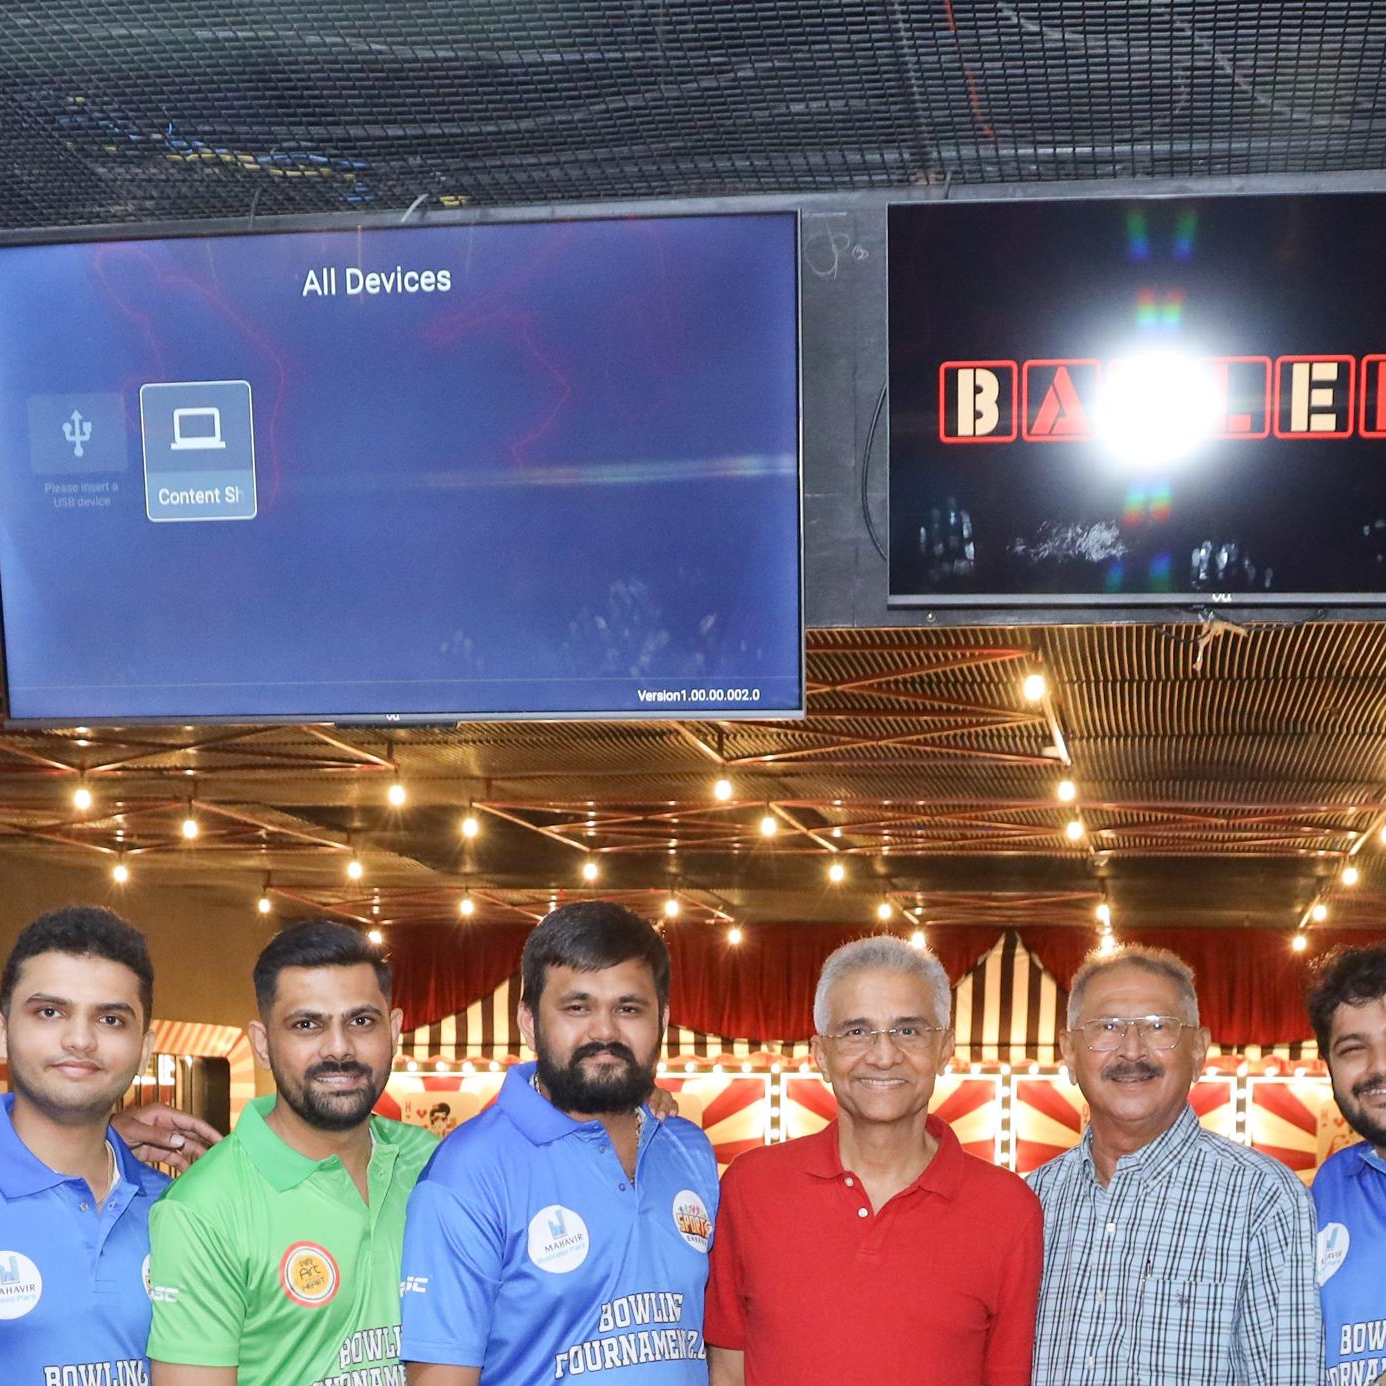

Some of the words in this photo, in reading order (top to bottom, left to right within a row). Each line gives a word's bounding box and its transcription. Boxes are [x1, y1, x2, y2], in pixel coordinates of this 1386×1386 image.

[301, 268, 337, 296] All
[346, 266, 452, 295] Devices
[158, 487, 220, 505] Content
[637, 687, 760, 704] Version1.00.00.002.0
